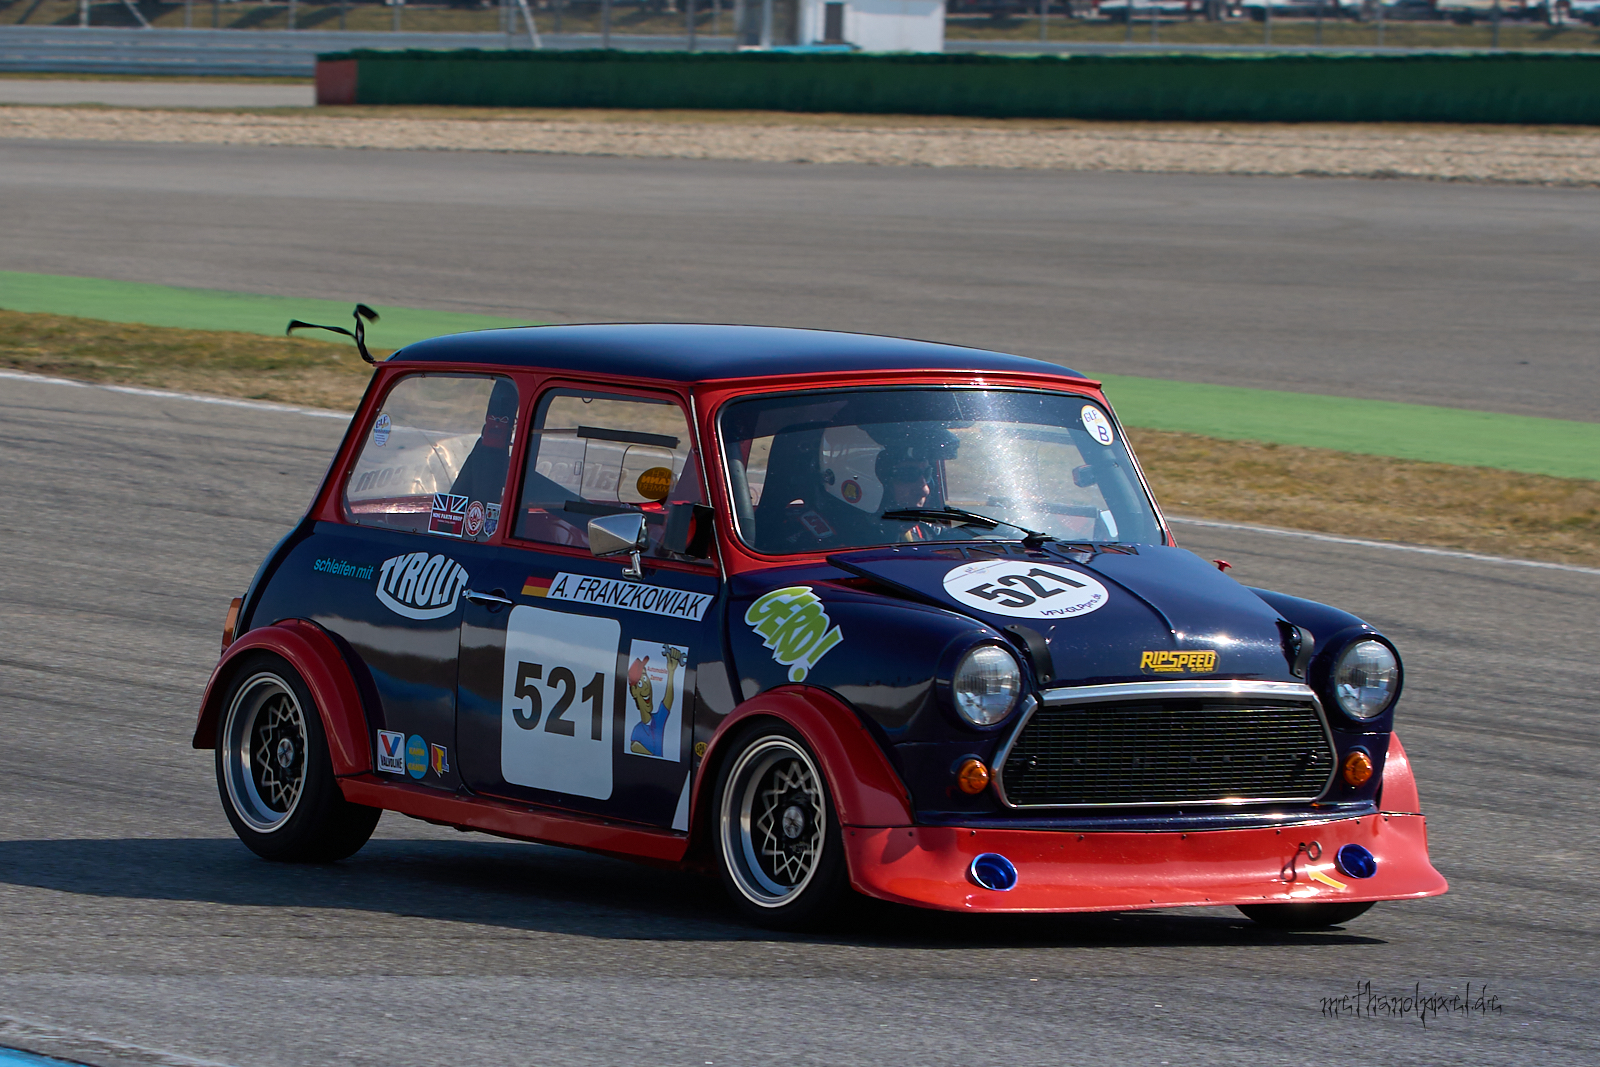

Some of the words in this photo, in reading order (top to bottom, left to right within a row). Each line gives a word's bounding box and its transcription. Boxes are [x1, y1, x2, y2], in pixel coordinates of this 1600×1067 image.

[1084, 410, 1097, 422] GLP
[1097, 425, 1109, 442] B
[313, 558, 356, 577] schleifen
[356, 565, 374, 580] mit
[376, 551, 469, 607] TYROLIT
[552, 575, 568, 598] A.
[573, 578, 707, 618] FRANZKOWIAK
[965, 567, 1087, 608] 521
[1140, 651, 1216, 668] RIPSPEED
[512, 660, 605, 742] 521
[381, 755, 402, 769] VALVOLINE
